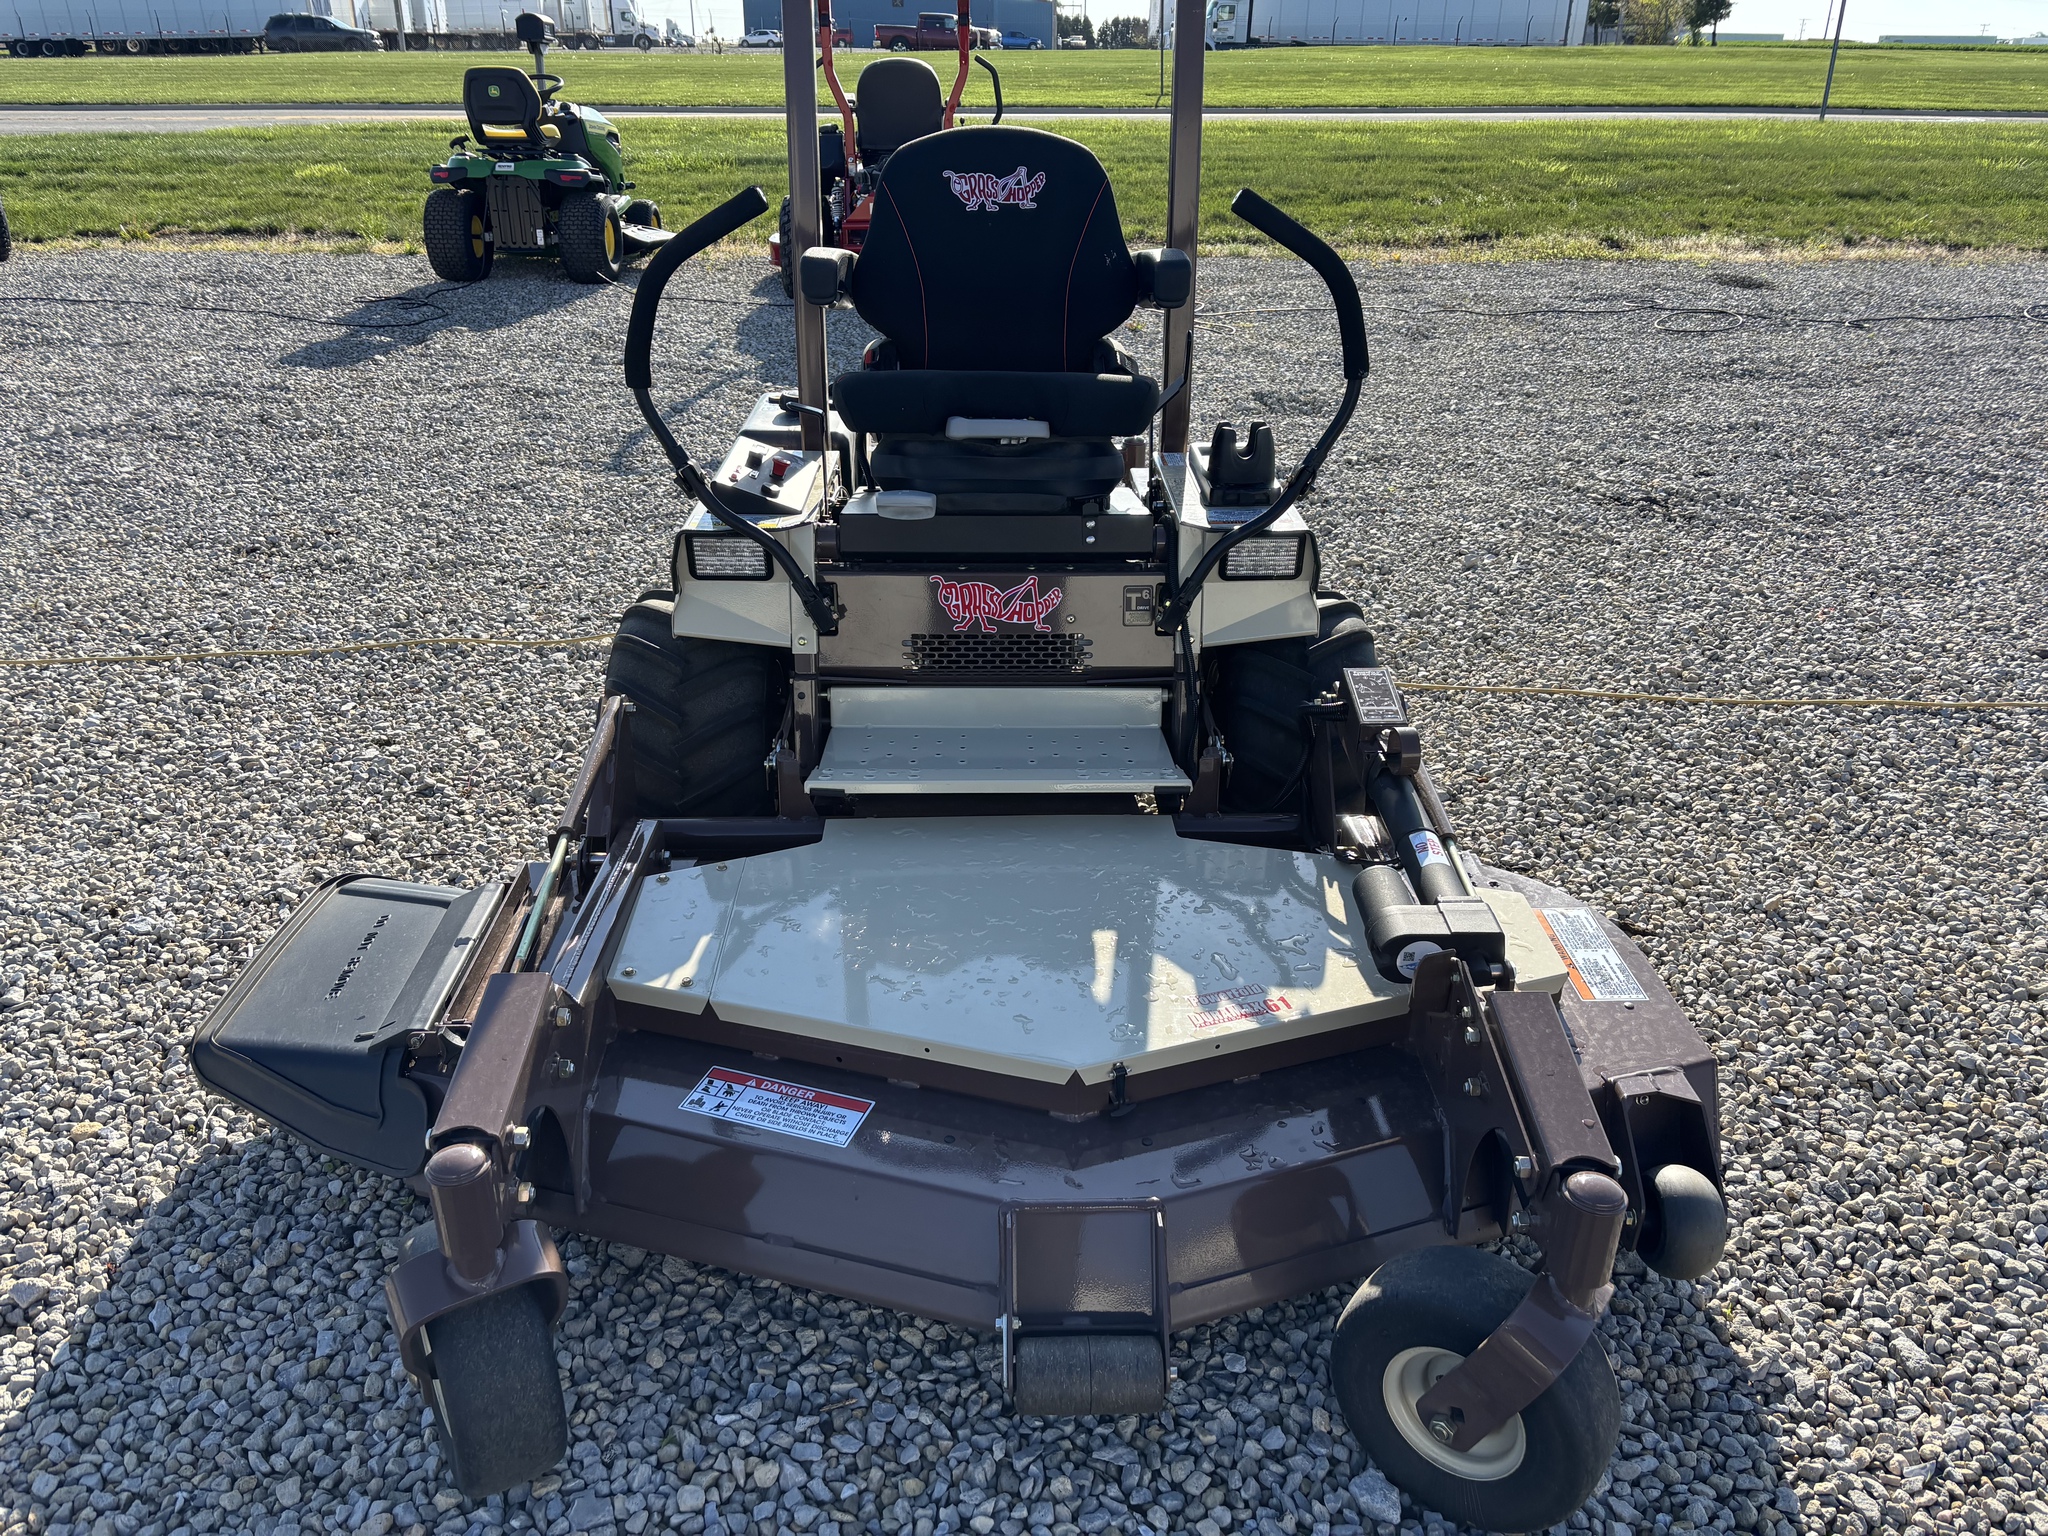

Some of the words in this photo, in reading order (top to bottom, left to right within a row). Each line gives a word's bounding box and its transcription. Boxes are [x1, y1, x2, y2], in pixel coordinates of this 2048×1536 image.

[1415, 841, 1429, 855] NO
[1427, 838, 1443, 856] STEP
[373, 913, 392, 929] DO
[356, 930, 380, 951] NOT
[324, 955, 364, 1001] REMOVE
[1263, 996, 1293, 1013] 61
[760, 1080, 816, 1100] DANGER
[747, 1098, 768, 1107] DEATH
[768, 1103, 788, 1111] FROM
[789, 1107, 817, 1118] THROWN
[818, 1114, 846, 1125] OBJECTS
[763, 1096, 785, 1105] AVOID
[785, 1101, 812, 1112] SERIOUS
[812, 1107, 835, 1117] INJURY
[778, 1094, 800, 1104] KEEP
[800, 1099, 827, 1110] AWAY!
[731, 1105, 752, 1114] NEVER
[753, 1110, 781, 1121] OPERATE
[781, 1116, 810, 1128] WITHOUT
[810, 1123, 849, 1137] DISCHARGE
[734, 1111, 755, 1120] CHUTE
[767, 1118, 781, 1126] SIDE
[781, 1122, 807, 1132] SHIELDS
[771, 1109, 792, 1118] BLADE
